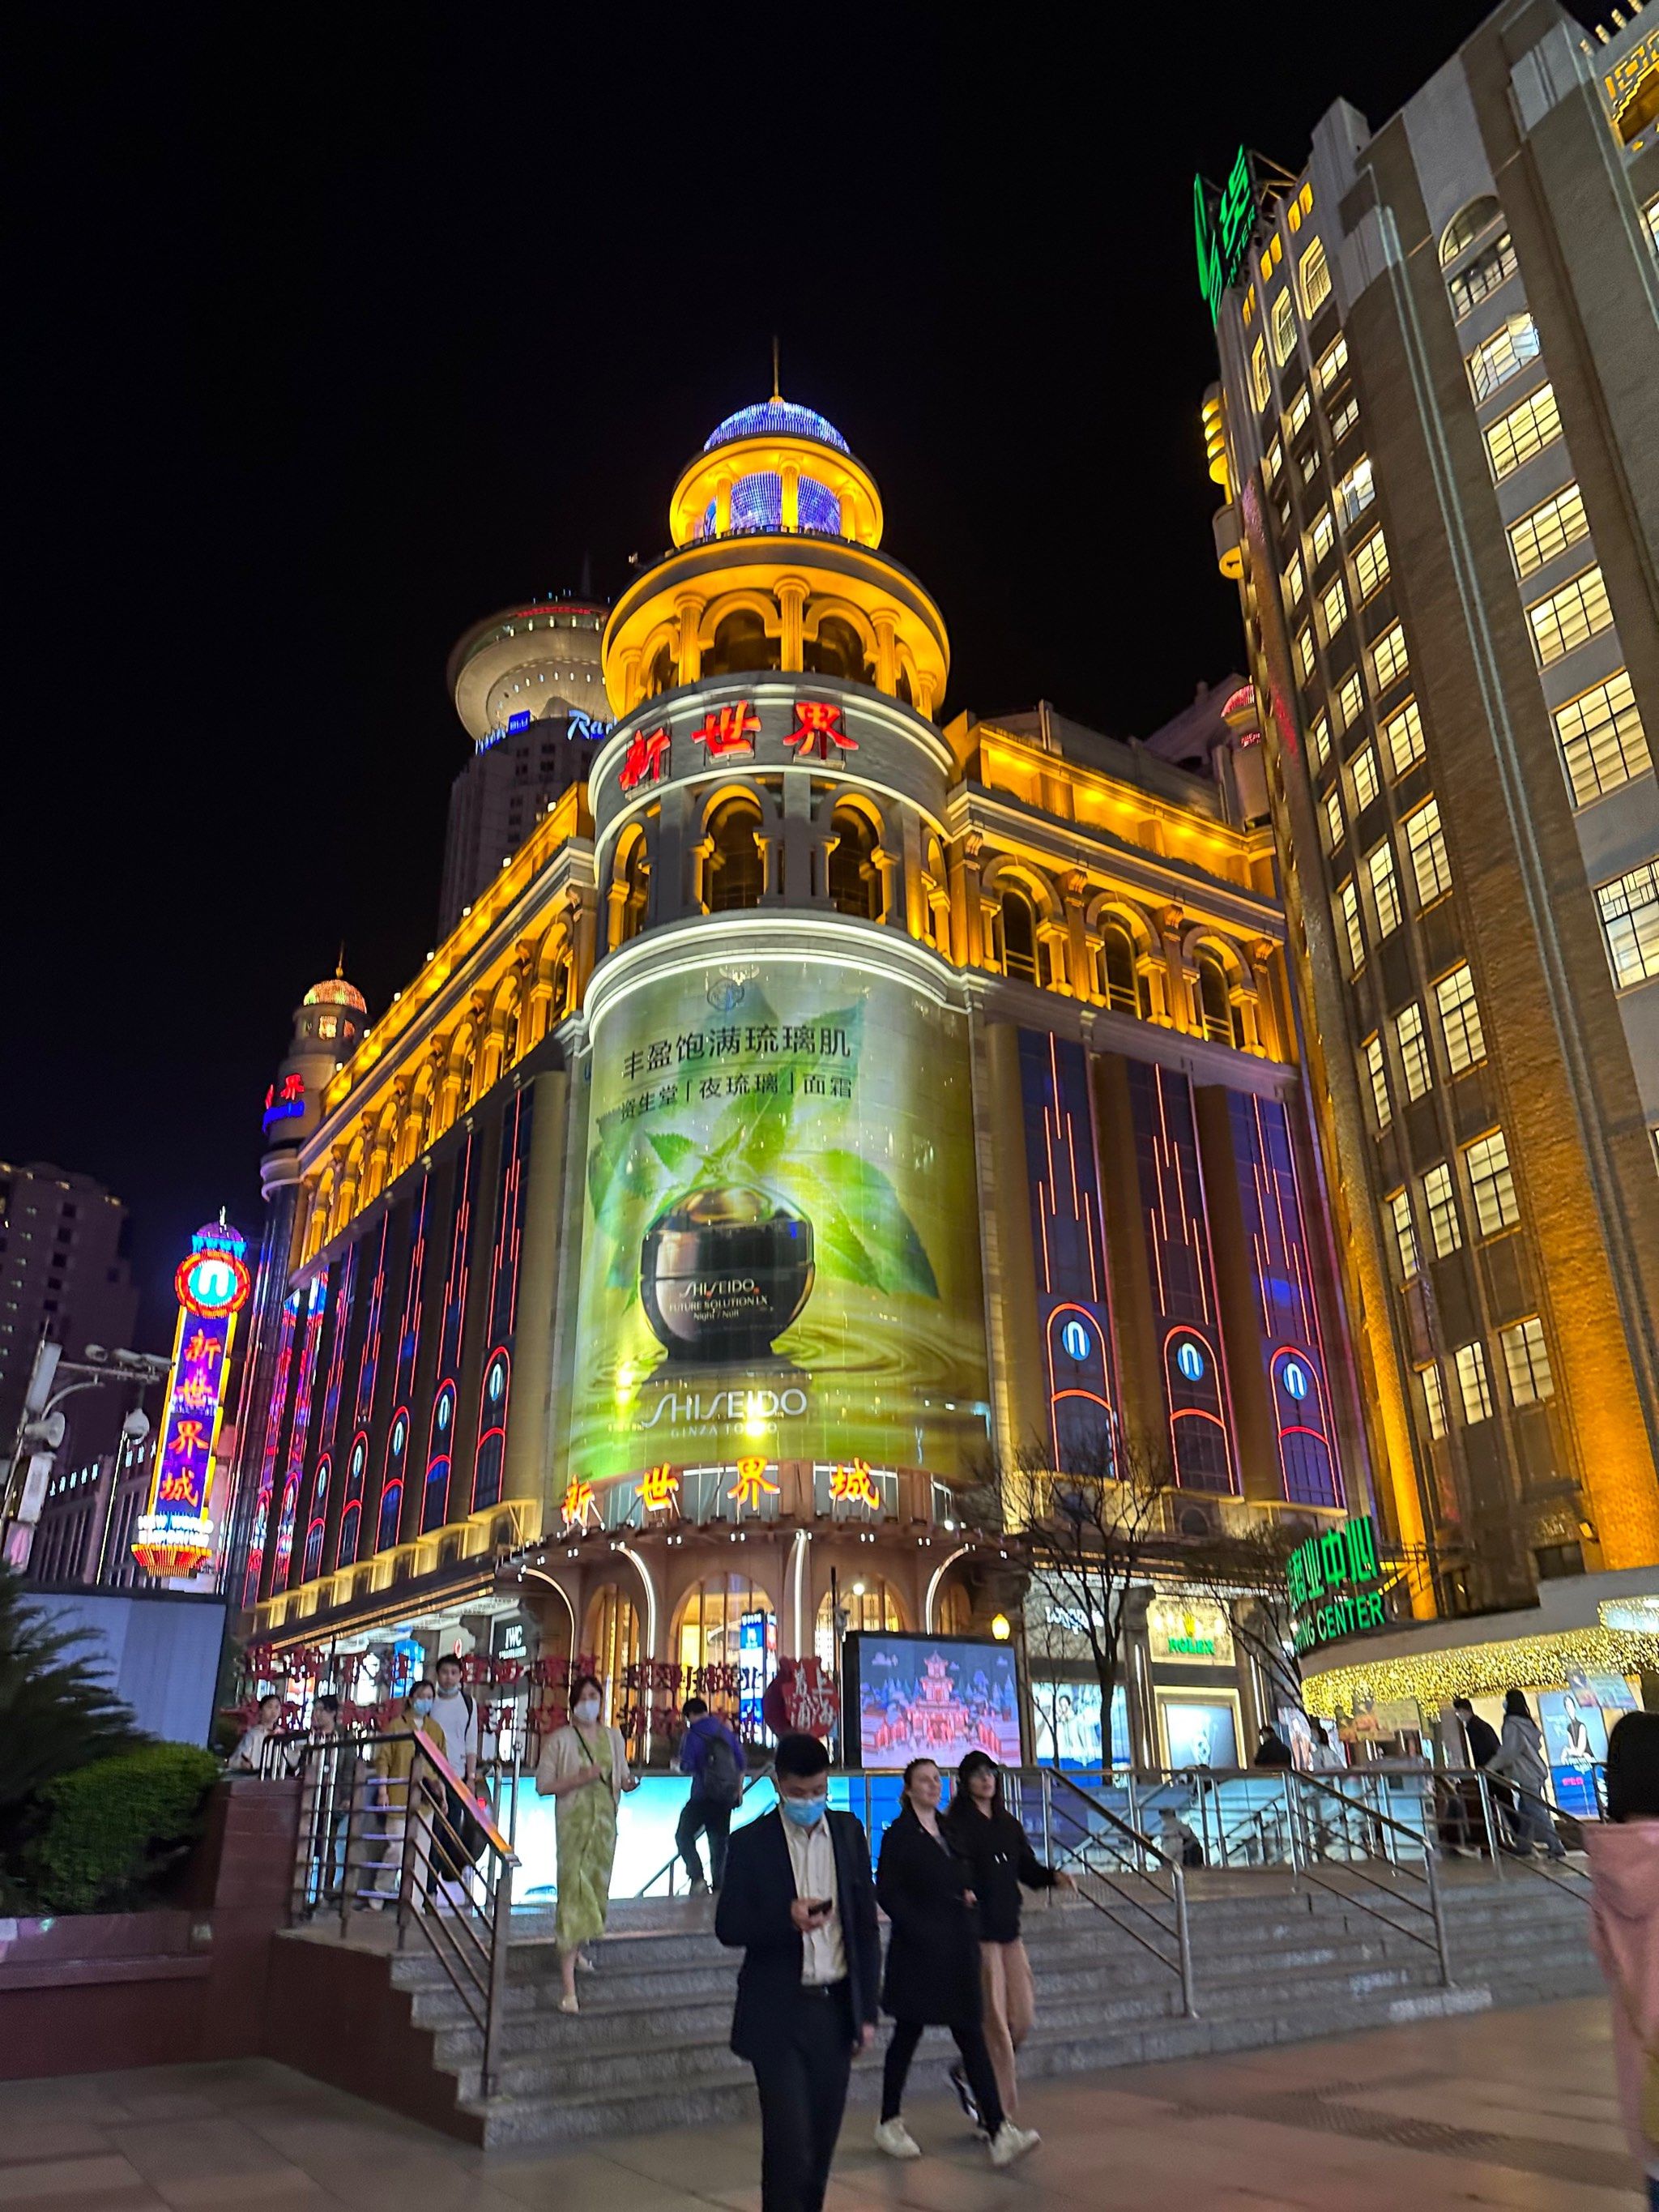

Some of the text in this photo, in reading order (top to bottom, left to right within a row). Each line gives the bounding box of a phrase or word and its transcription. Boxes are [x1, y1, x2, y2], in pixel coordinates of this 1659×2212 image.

[619, 700, 859, 792] 新世界
[623, 1024, 851, 1081] 丰盈饱满琉璃肌
[803, 1073, 851, 1100] 面霜
[669, 1301, 702, 1313] FUTURE
[704, 1296, 754, 1311] SOLUTION
[680, 1278, 755, 1299] SHISEIDO
[160, 1329, 221, 1507] 新世界城
[642, 1388, 808, 1428] SHISEIDO
[671, 1420, 778, 1439] GINZA TOO
[561, 1456, 881, 1528] 新世界城
[1316, 1591, 1385, 1642] CENTER
[1167, 1636, 1215, 1655] ROLEX
